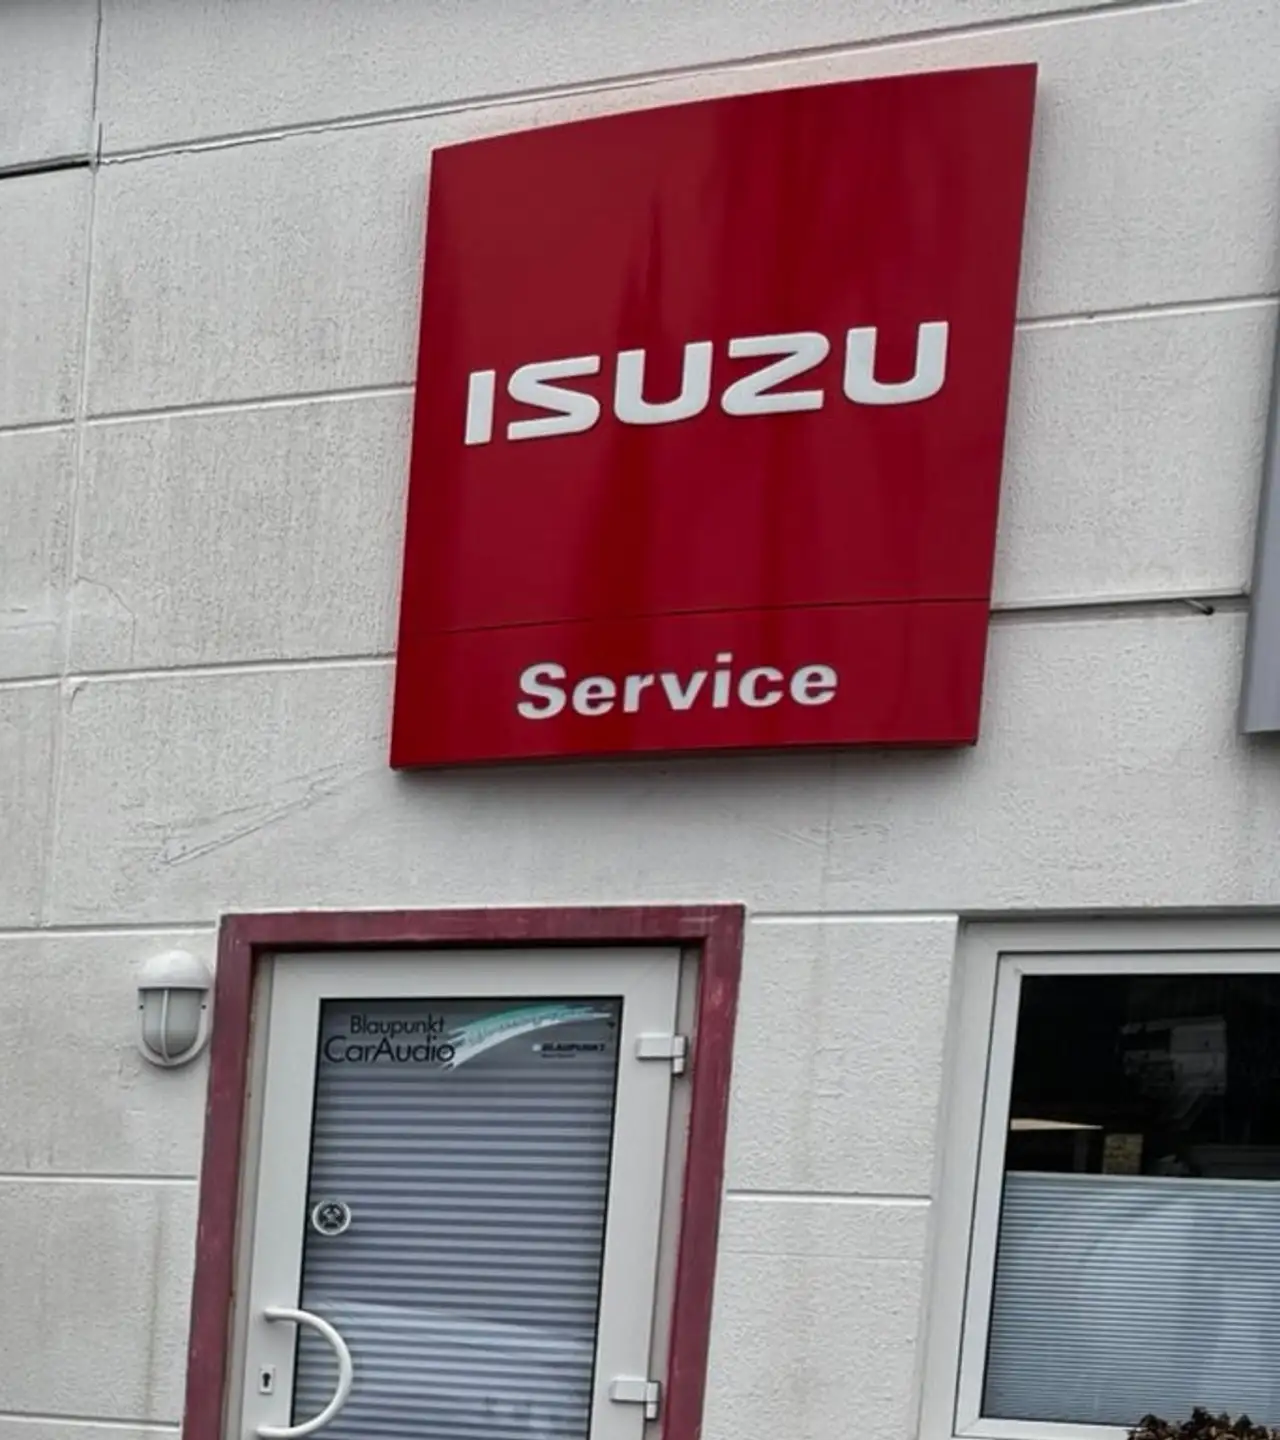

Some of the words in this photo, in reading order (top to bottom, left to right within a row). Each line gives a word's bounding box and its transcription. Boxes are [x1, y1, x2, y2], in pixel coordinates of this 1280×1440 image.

[465, 321, 949, 445] ISUZU
[516, 653, 839, 720] Service
[324, 1035, 455, 1063] CarAudio
[350, 1013, 444, 1039] Blaupunkt
